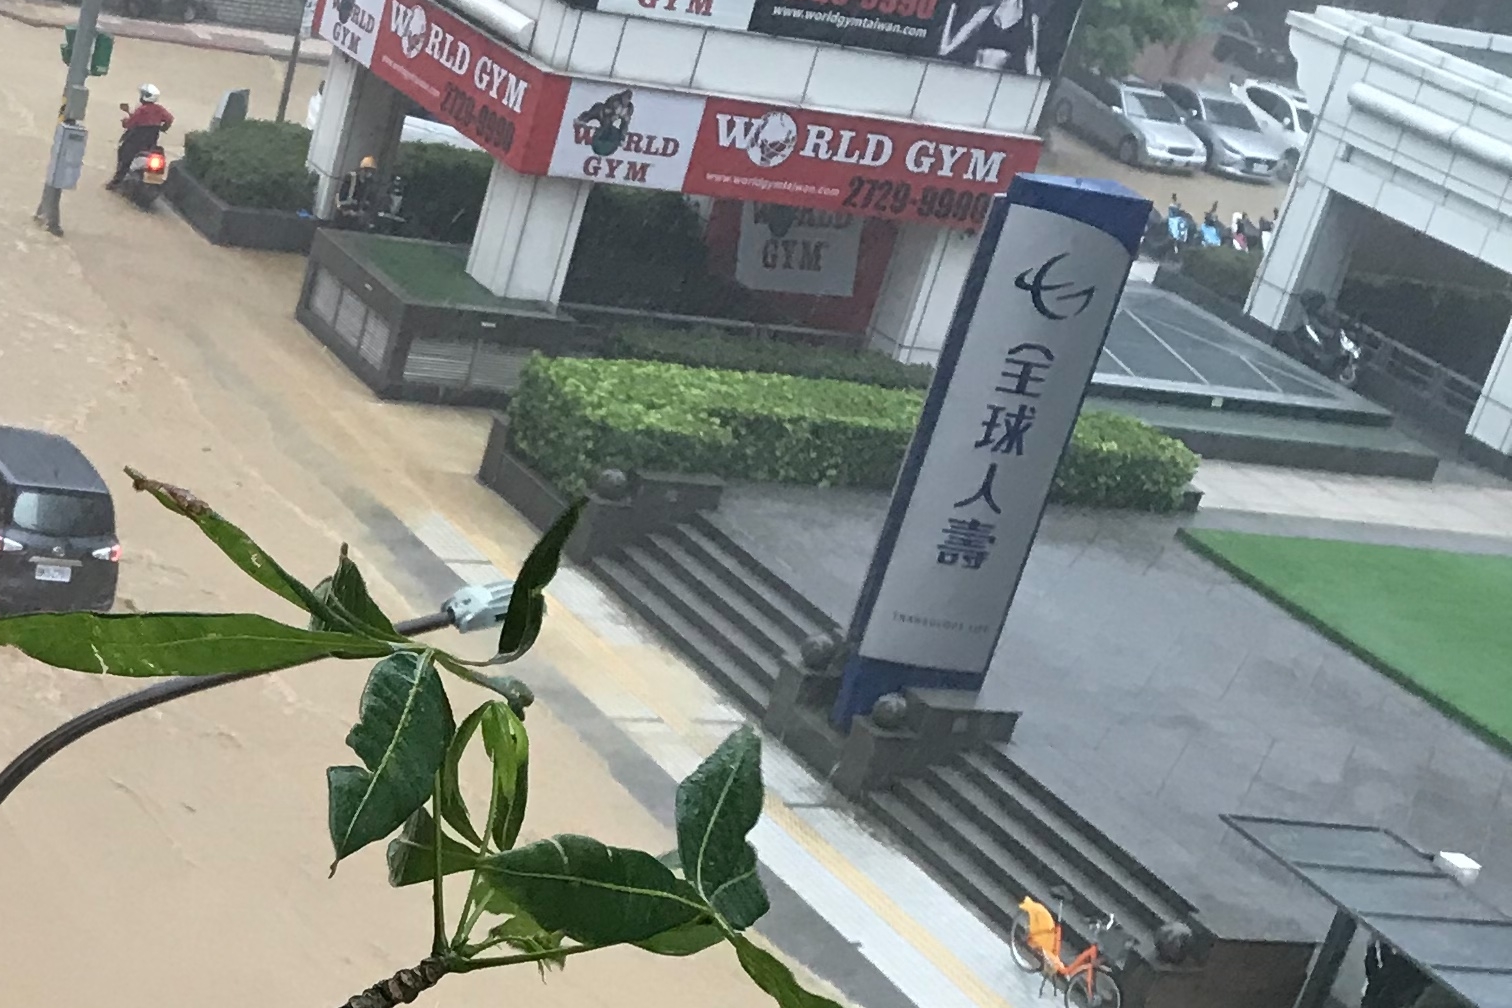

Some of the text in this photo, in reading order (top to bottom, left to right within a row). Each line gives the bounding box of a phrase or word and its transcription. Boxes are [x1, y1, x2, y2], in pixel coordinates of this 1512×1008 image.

[332, 21, 362, 55] GYM
[772, 5, 928, 39] www.worldgymtaiwan.com
[474, 56, 529, 114] GYM
[573, 124, 680, 158] WORLD
[716, 111, 1007, 183] WORLD GYM
[583, 156, 651, 183] GYM
[761, 239, 823, 272] GYM
[937, 342, 1056, 570] 全球人壽
